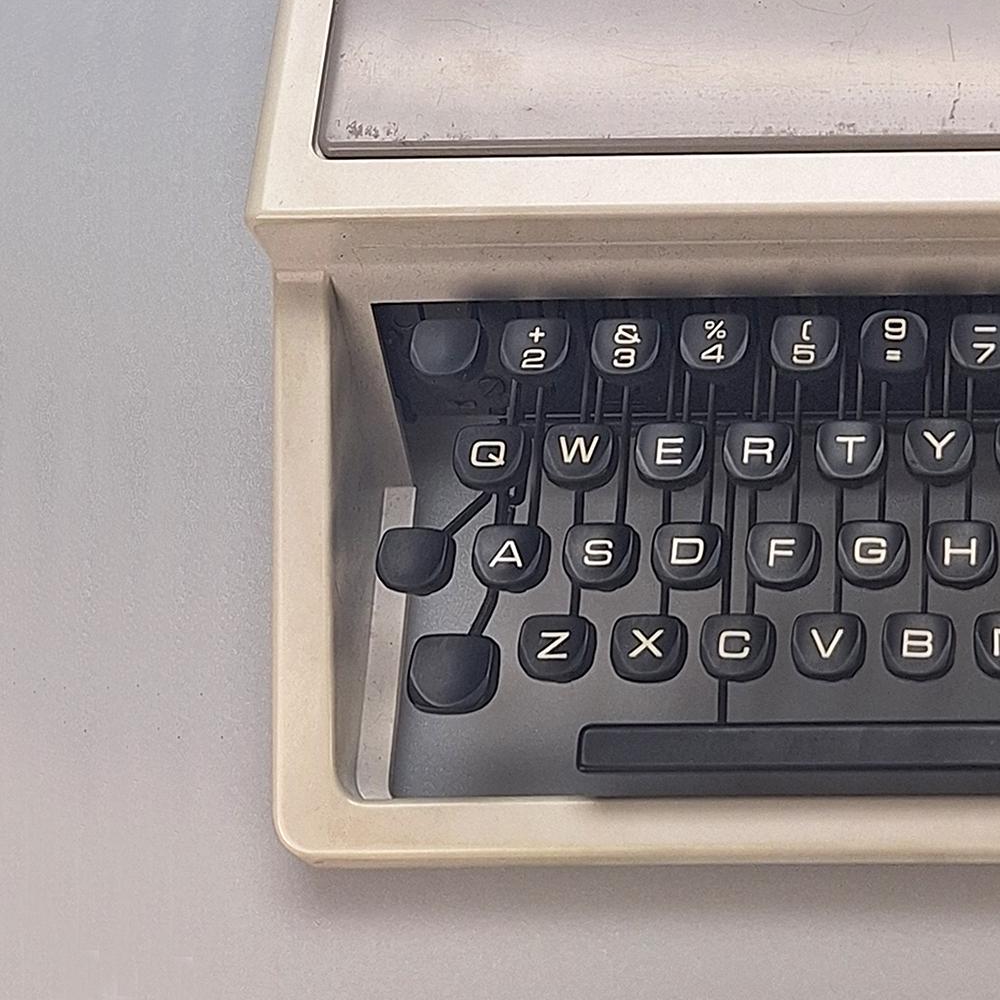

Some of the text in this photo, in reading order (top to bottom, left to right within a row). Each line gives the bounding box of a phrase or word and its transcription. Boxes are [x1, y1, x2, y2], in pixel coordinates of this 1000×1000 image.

[614, 324, 641, 345] &
[704, 320, 727, 340] %
[521, 348, 546, 369] 2
[613, 348, 636, 368] 3
[700, 343, 725, 364] 4
[792, 344, 816, 364] 5
[972, 343, 996, 364] 7
[470, 441, 506, 467] Q
[559, 435, 599, 463] W
[655, 437, 684, 465] E
[742, 437, 775, 464] R
[835, 436, 866, 464] T
[923, 431, 956, 460] Y
[488, 540, 523, 568] A
[583, 539, 613, 566] S
[670, 537, 704, 565] D
[768, 538, 796, 567] F
[854, 537, 887, 564] G
[943, 537, 977, 566] H
[537, 631, 570, 659] Z
[628, 629, 664, 658] X
[718, 630, 751, 659] C
[811, 628, 844, 658] V
[902, 629, 933, 658] B
